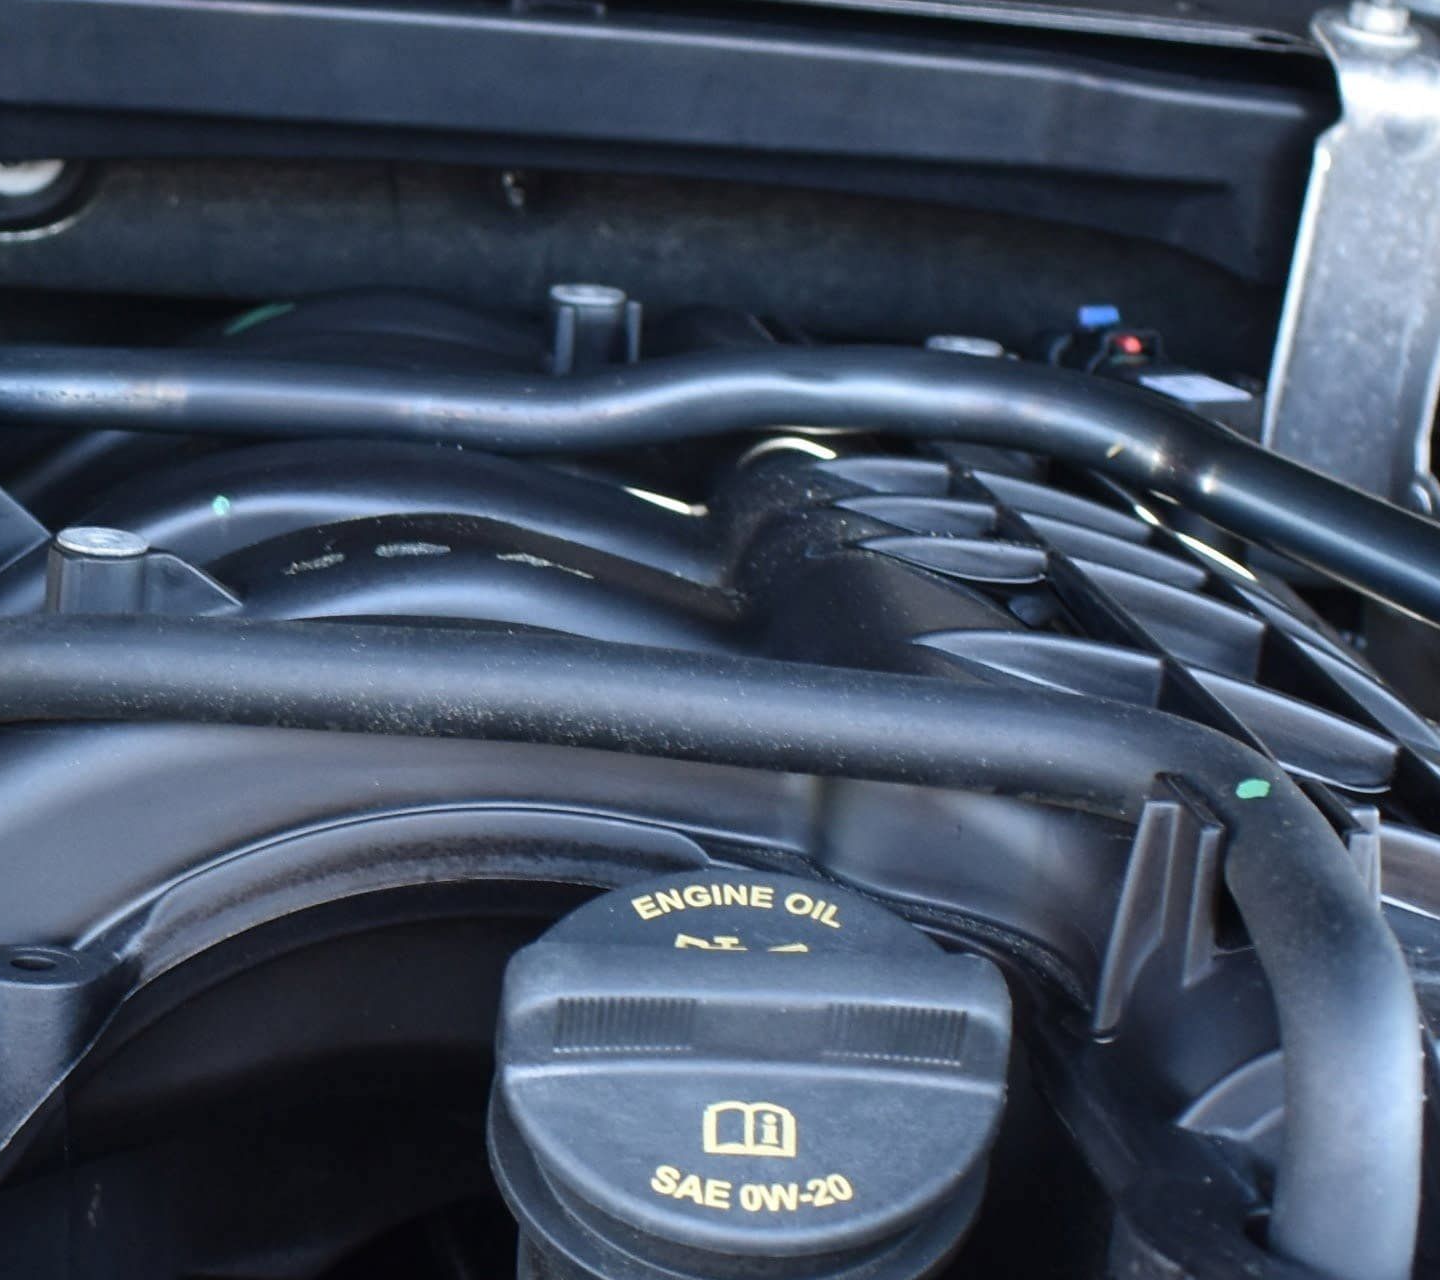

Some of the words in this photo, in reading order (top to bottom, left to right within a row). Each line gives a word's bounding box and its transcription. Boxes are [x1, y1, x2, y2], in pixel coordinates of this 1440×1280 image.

[632, 884, 774, 921] ENGINE
[784, 892, 843, 929] OIL
[649, 1164, 731, 1210] SAE
[738, 1172, 854, 1213] 0W-20
